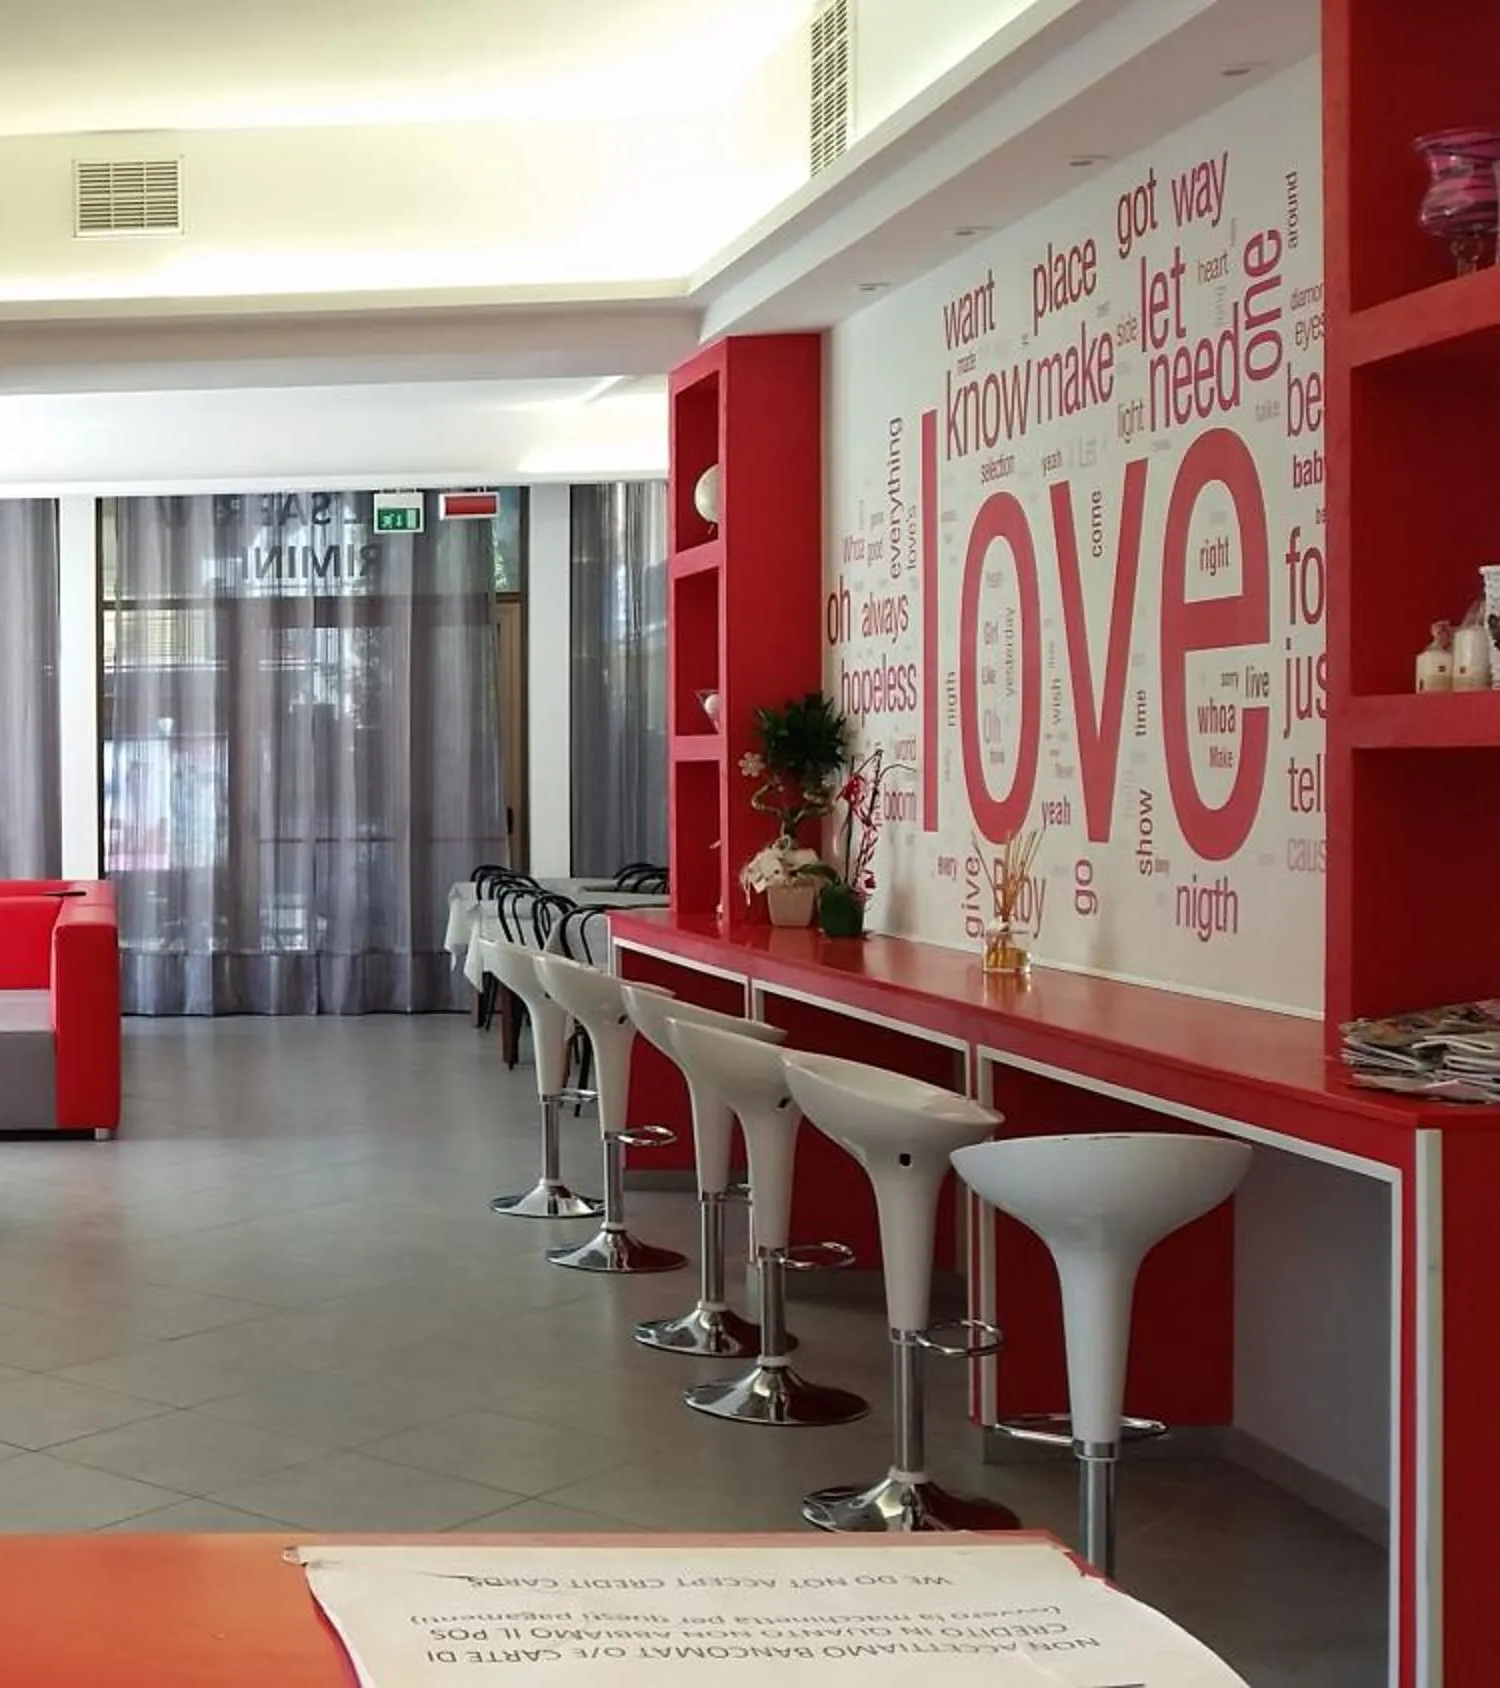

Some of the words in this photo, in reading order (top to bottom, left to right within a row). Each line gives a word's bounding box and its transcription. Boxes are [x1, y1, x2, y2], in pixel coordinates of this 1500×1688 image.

[1171, 150, 1229, 228] way
[1285, 170, 1299, 249] around
[1117, 167, 1158, 259] got
[1033, 238, 1097, 336] place
[1197, 252, 1230, 284] heart
[943, 269, 996, 350] want
[1140, 245, 1187, 352] let
[1243, 229, 1283, 382] one
[1037, 320, 1115, 424] make
[1150, 302, 1241, 432] need
[946, 359, 1032, 460] know
[1116, 399, 1146, 444] light
[980, 452, 1016, 485] selection
[1041, 451, 1062, 476] yeah
[887, 417, 904, 579] everything
[1091, 489, 1104, 558] come
[1199, 536, 1231, 577] right
[827, 574, 851, 646] oh
[861, 592, 909, 643] always
[921, 409, 1271, 862] love
[1003, 606, 1017, 698] yesterday
[840, 652, 918, 729] hopeless
[1051, 677, 1062, 726] wish
[1244, 665, 1270, 699] live
[1134, 689, 1148, 737] time
[1197, 697, 1237, 735] whoa
[1287, 753, 1328, 814] tel
[1041, 796, 1071, 831] yeah
[1136, 788, 1154, 877] show
[961, 856, 985, 939] give
[1074, 858, 1099, 916] go
[1174, 873, 1239, 943] nigth
[571, 1576, 666, 1590] CREDIT
[677, 1576, 776, 1589] ACCEPT
[790, 1575, 848, 1589] NOT
[854, 1574, 898, 1586] DO
[430, 1628, 489, 1642] POS
[495, 1627, 522, 1641] IL
[531, 1627, 672, 1641] ABBIAMO
[681, 1614, 725, 1625] per
[682, 1630, 752, 1640] NON
[760, 1626, 893, 1639] QUANTO
[900, 1626, 934, 1638] IN
[941, 1622, 1069, 1639] CREDITO
[426, 1649, 458, 1664] DI
[465, 1649, 562, 1664] CARTE
[572, 1646, 627, 1660] O/E
[640, 1646, 815, 1660] BANCOMAT
[822, 1641, 1017, 1660] ACCETTIAMO
[1028, 1636, 1102, 1651] NON
